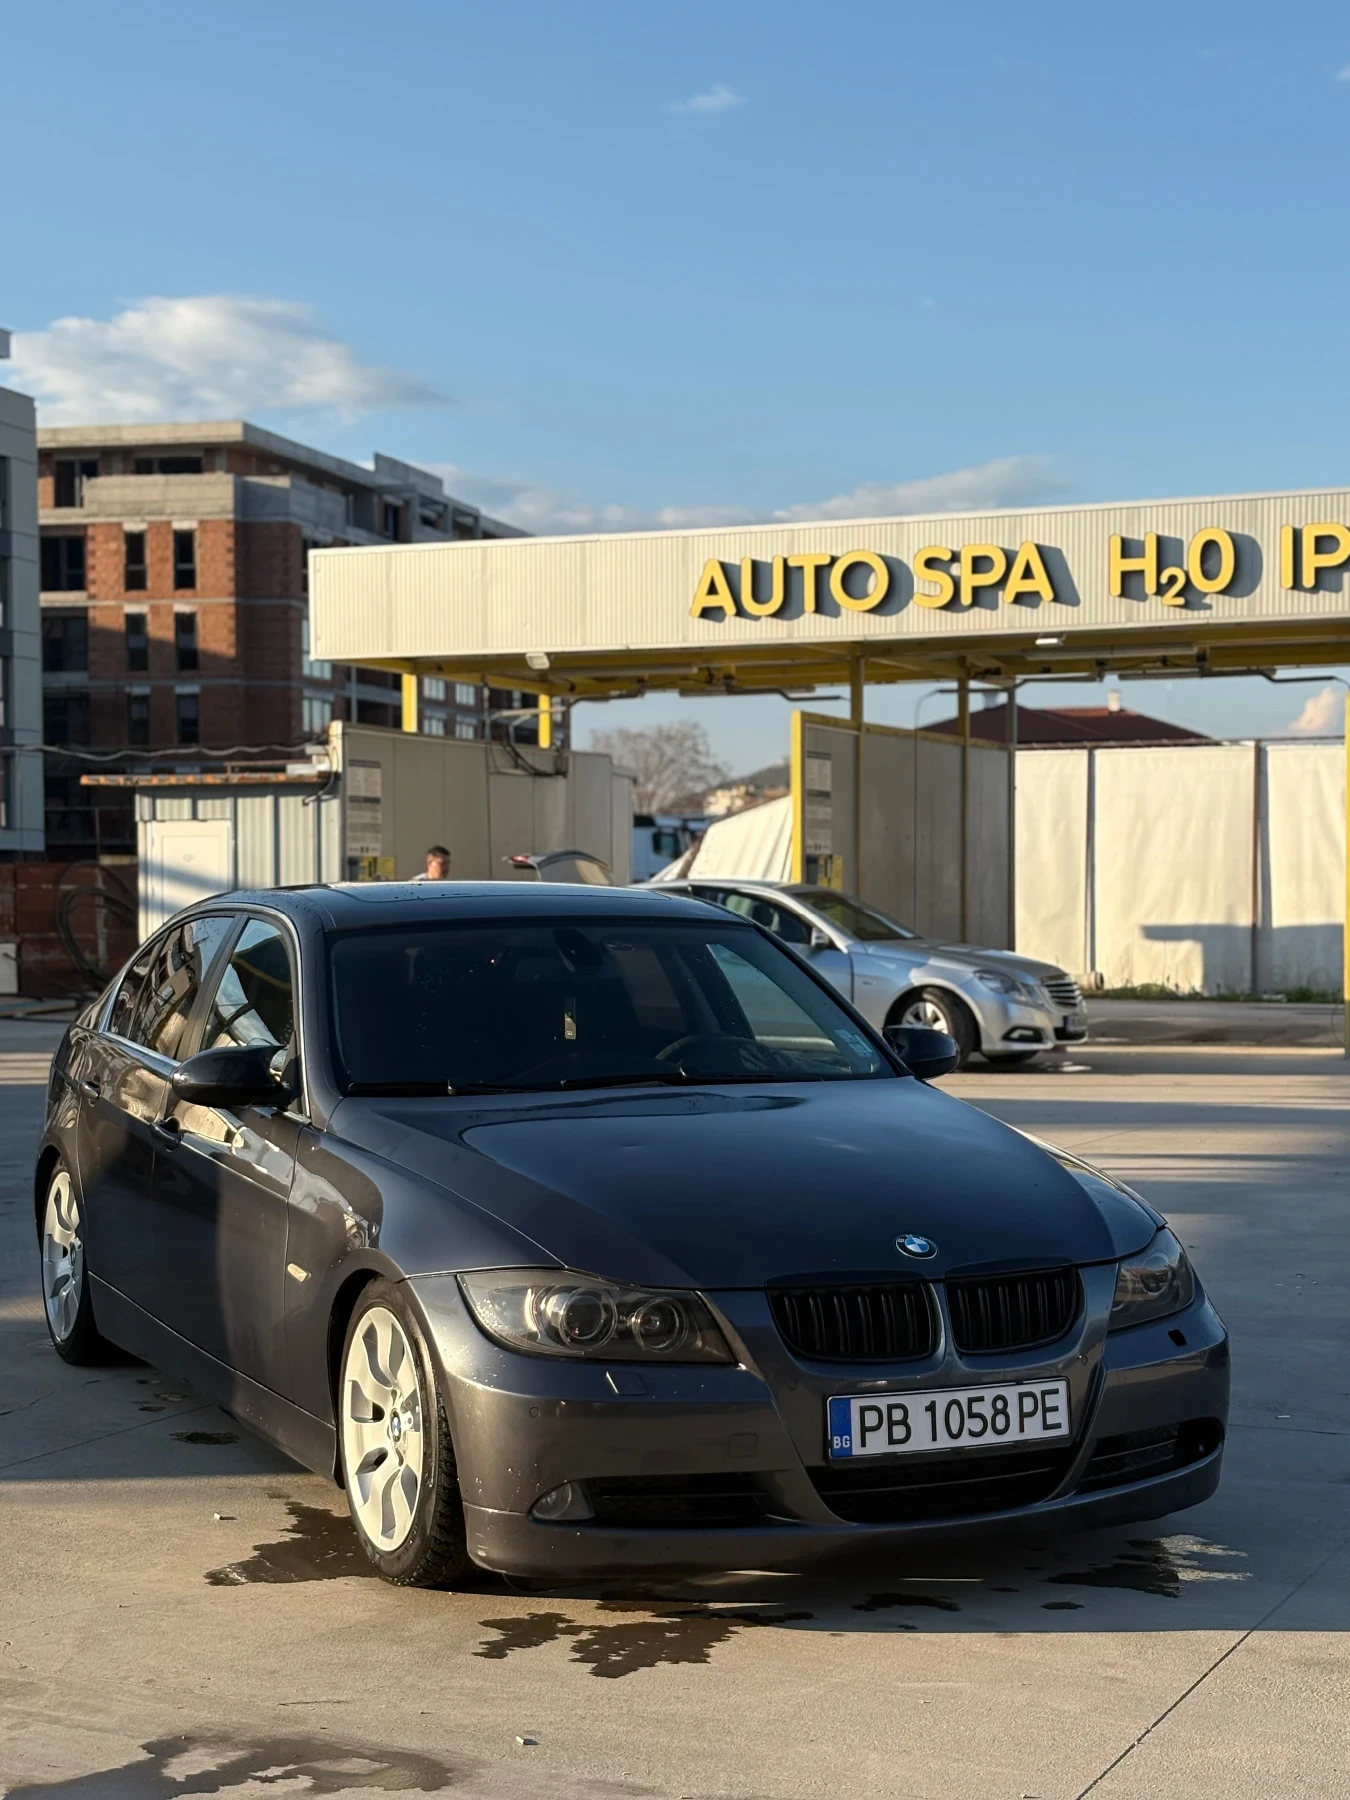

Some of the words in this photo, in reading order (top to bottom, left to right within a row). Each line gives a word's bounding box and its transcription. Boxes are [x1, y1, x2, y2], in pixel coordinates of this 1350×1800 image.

[689, 549, 889, 617] AUTO
[913, 540, 1054, 609] SPA
[1280, 522, 1350, 590] IP
[833, 1435, 850, 1449] BG
[859, 1402, 912, 1447] PB
[924, 1394, 1011, 1442] 1058
[1018, 1388, 1062, 1433] PE
